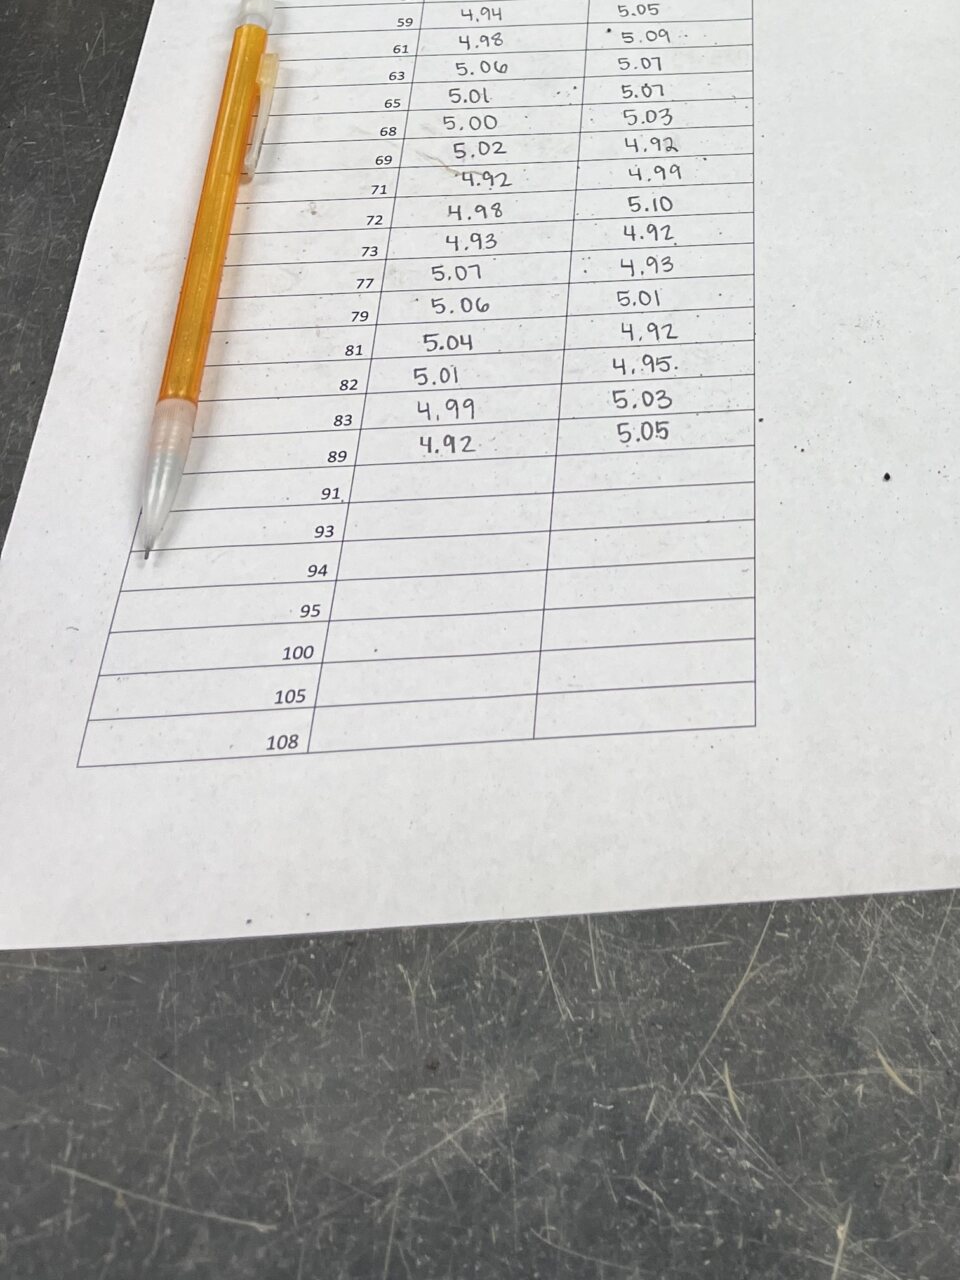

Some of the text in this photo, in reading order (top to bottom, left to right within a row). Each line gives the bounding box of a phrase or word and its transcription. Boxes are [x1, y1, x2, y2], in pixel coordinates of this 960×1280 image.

[460, 6, 503, 23] 4.94
[616, 2, 660, 18] 5.05
[396, 17, 414, 28] 59
[458, 31, 504, 51] 4.98
[620, 28, 671, 45] 5.09
[392, 44, 409, 55] 61
[454, 59, 509, 77] 5.06
[617, 56, 663, 72] 5.07
[388, 70, 406, 82] 63
[448, 87, 490, 104] 5.01
[620, 82, 665, 100] 5.07
[383, 98, 402, 109] 65
[442, 114, 499, 132] 5.00
[622, 107, 674, 127] 5.03
[379, 126, 398, 137] 68
[452, 140, 508, 160] 5.02
[624, 136, 680, 154] 4.92
[374, 154, 393, 166] 69
[460, 170, 514, 189] 4.92
[627, 163, 683, 182] 4.99
[371, 184, 388, 196] 71
[447, 201, 504, 222] 4.98
[627, 195, 674, 213] 5.10
[366, 214, 384, 226] 72
[623, 223, 675, 242] 4.92
[445, 232, 498, 252] 4.93
[361, 245, 379, 258] 73
[430, 263, 482, 282] 5.07
[619, 255, 675, 278] 4.93
[356, 277, 375, 290] 77
[430, 296, 491, 315] 5.06
[616, 289, 661, 308] 5.01
[351, 310, 370, 323] 79
[620, 321, 679, 342] 4.92
[344, 344, 363, 357] 81
[422, 332, 474, 353] 5.04
[612, 353, 673, 376] 4.95
[338, 378, 359, 392] 82
[412, 366, 459, 387] 5.01
[611, 389, 674, 410] 5.03
[416, 397, 475, 422] 4.99
[332, 413, 353, 428] 83
[616, 420, 670, 444] 5.05
[419, 433, 477, 455] 4.92
[326, 449, 348, 464] 89
[320, 486, 340, 501] 91
[314, 524, 335, 539] 93
[307, 563, 328, 579] 94
[299, 603, 321, 619] 95
[282, 644, 315, 661] 100
[274, 688, 307, 705] 105
[266, 733, 300, 751] 108
